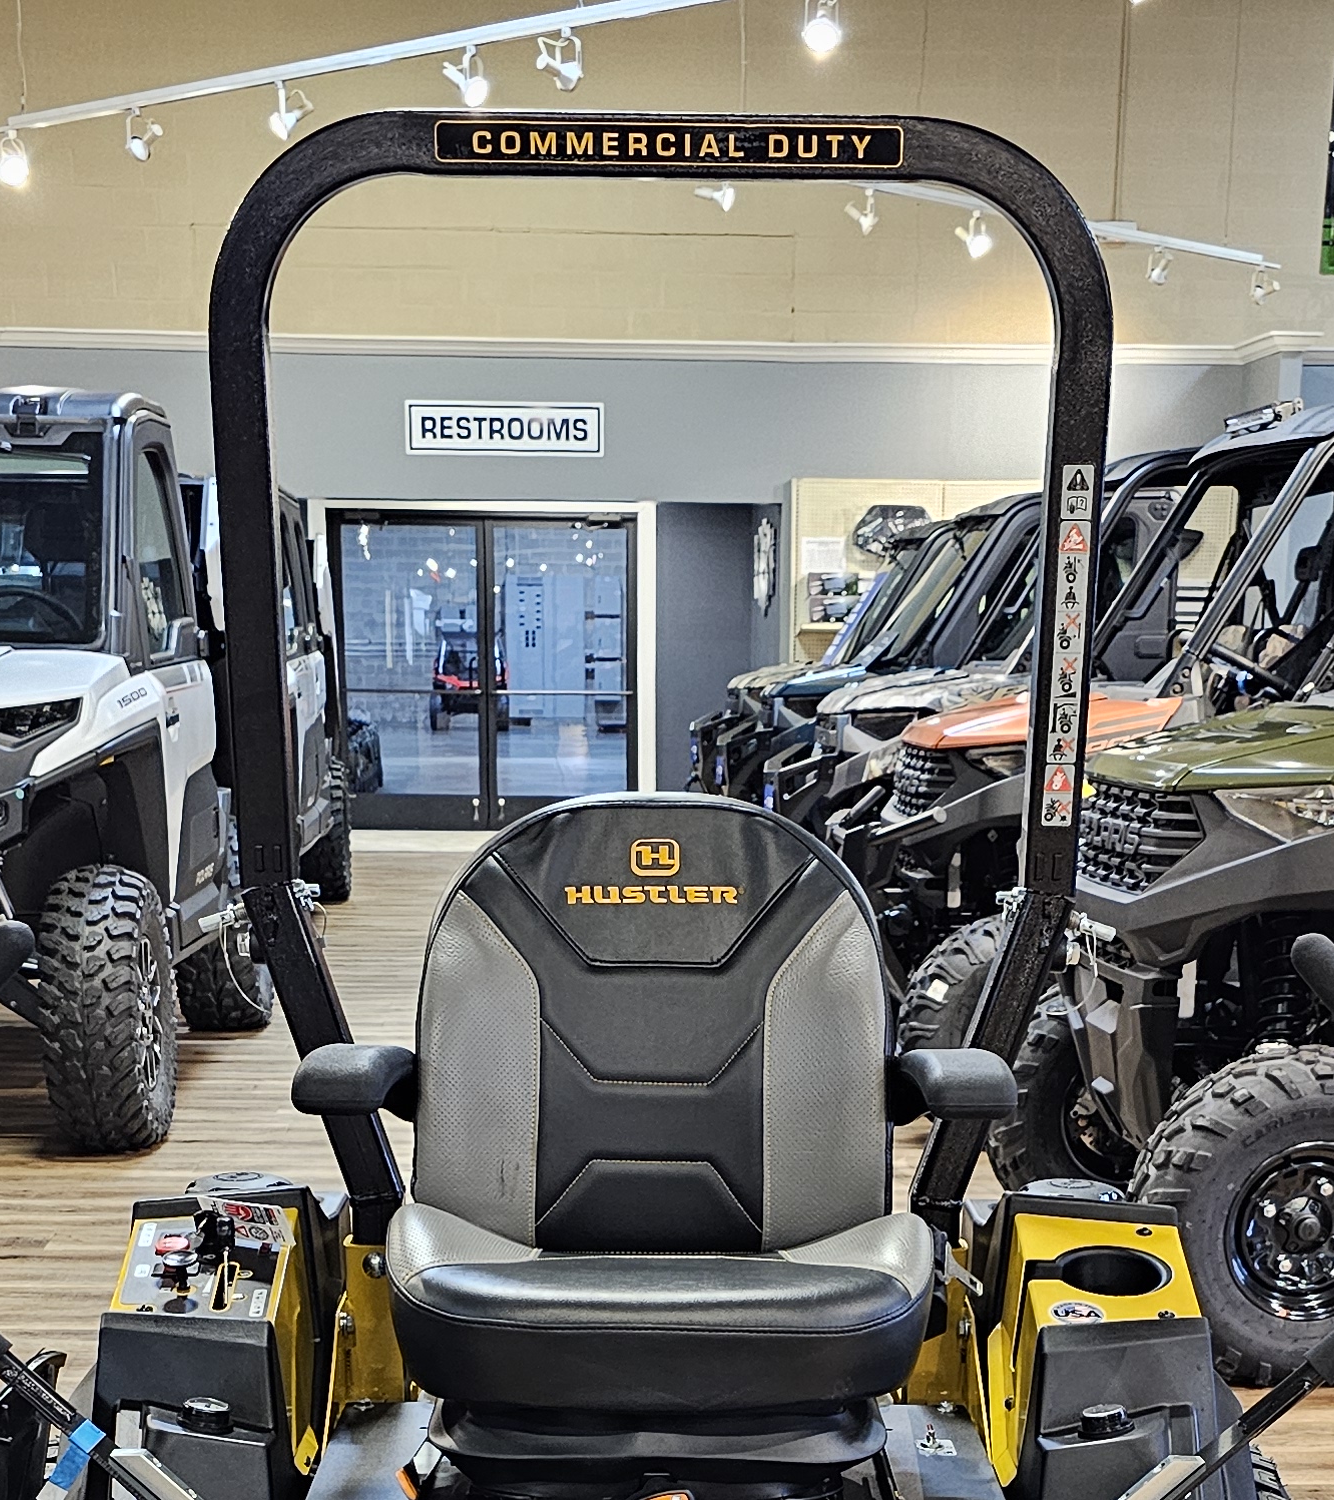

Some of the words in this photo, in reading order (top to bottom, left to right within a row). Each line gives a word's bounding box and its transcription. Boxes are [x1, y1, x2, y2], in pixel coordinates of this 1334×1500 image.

[471, 130, 746, 158] COMMERCIAL
[767, 133, 873, 160] DUTY
[420, 415, 590, 442] RESTROOMS
[116, 686, 149, 709] 1500
[564, 885, 739, 905] HUSTLER
[1053, 1308, 1103, 1319] USA
